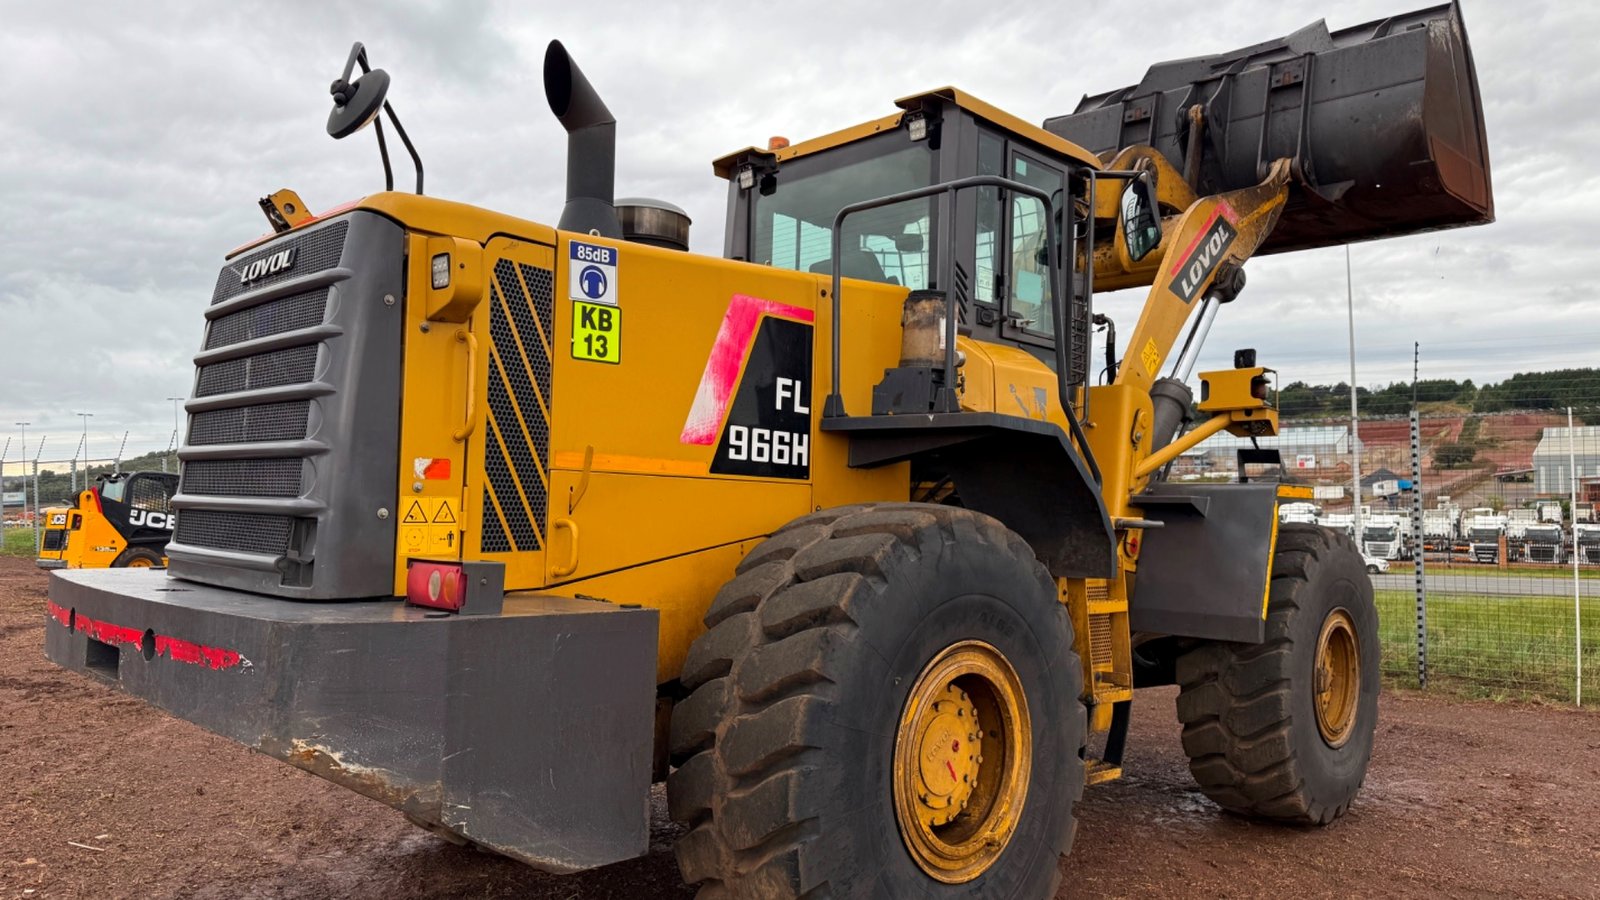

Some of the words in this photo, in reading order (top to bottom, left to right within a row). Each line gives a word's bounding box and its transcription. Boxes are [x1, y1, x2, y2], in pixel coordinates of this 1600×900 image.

[240, 249, 292, 284] LOVOL
[577, 245, 610, 263] 85dB
[1181, 225, 1229, 298] LOVOL
[581, 305, 613, 332] KB
[584, 334, 608, 359] 13
[776, 377, 809, 415] FL
[728, 425, 808, 466] 966H
